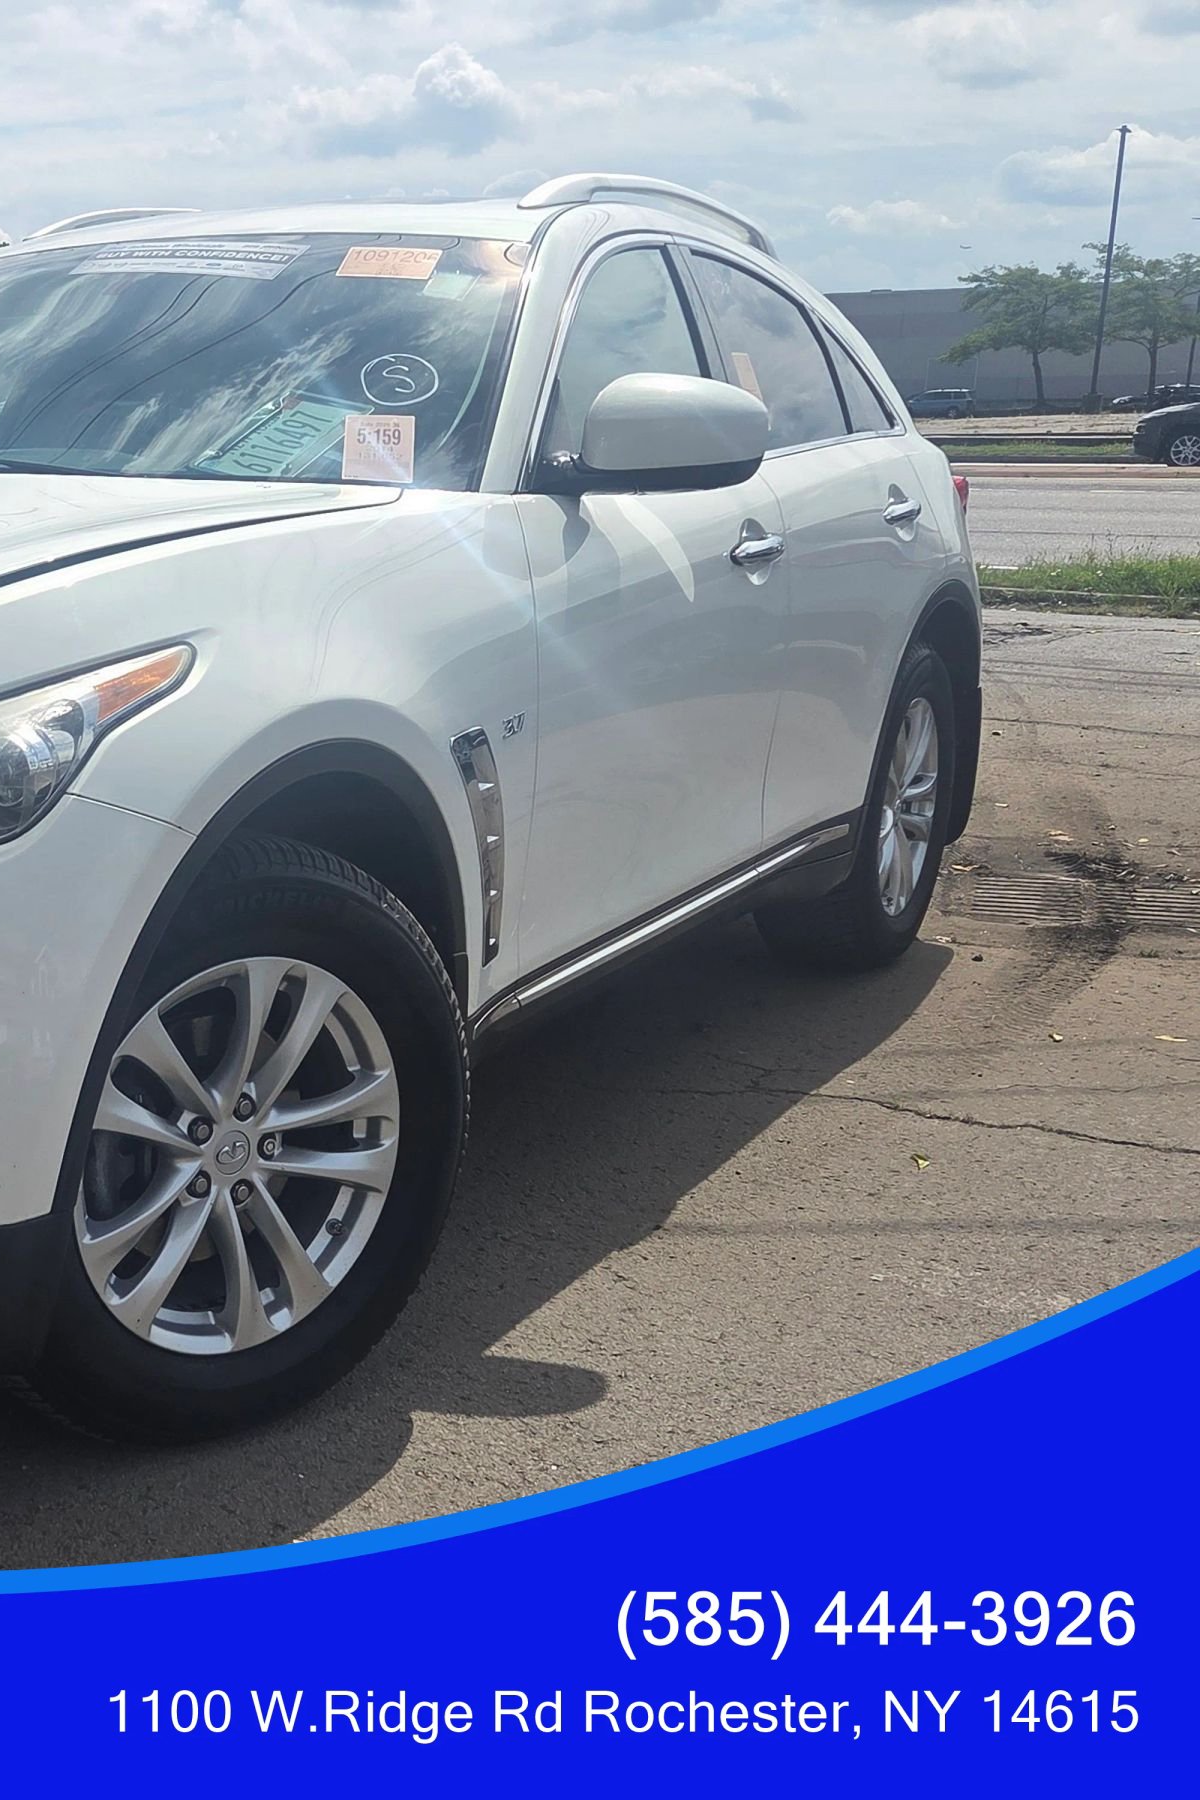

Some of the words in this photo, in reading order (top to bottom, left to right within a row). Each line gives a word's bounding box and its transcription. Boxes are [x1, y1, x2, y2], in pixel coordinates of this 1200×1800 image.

[95, 250, 131, 259] BUY
[131, 249, 173, 257] WITH
[174, 250, 290, 262] CONFIDENCE!
[232, 410, 334, 474] 6116497
